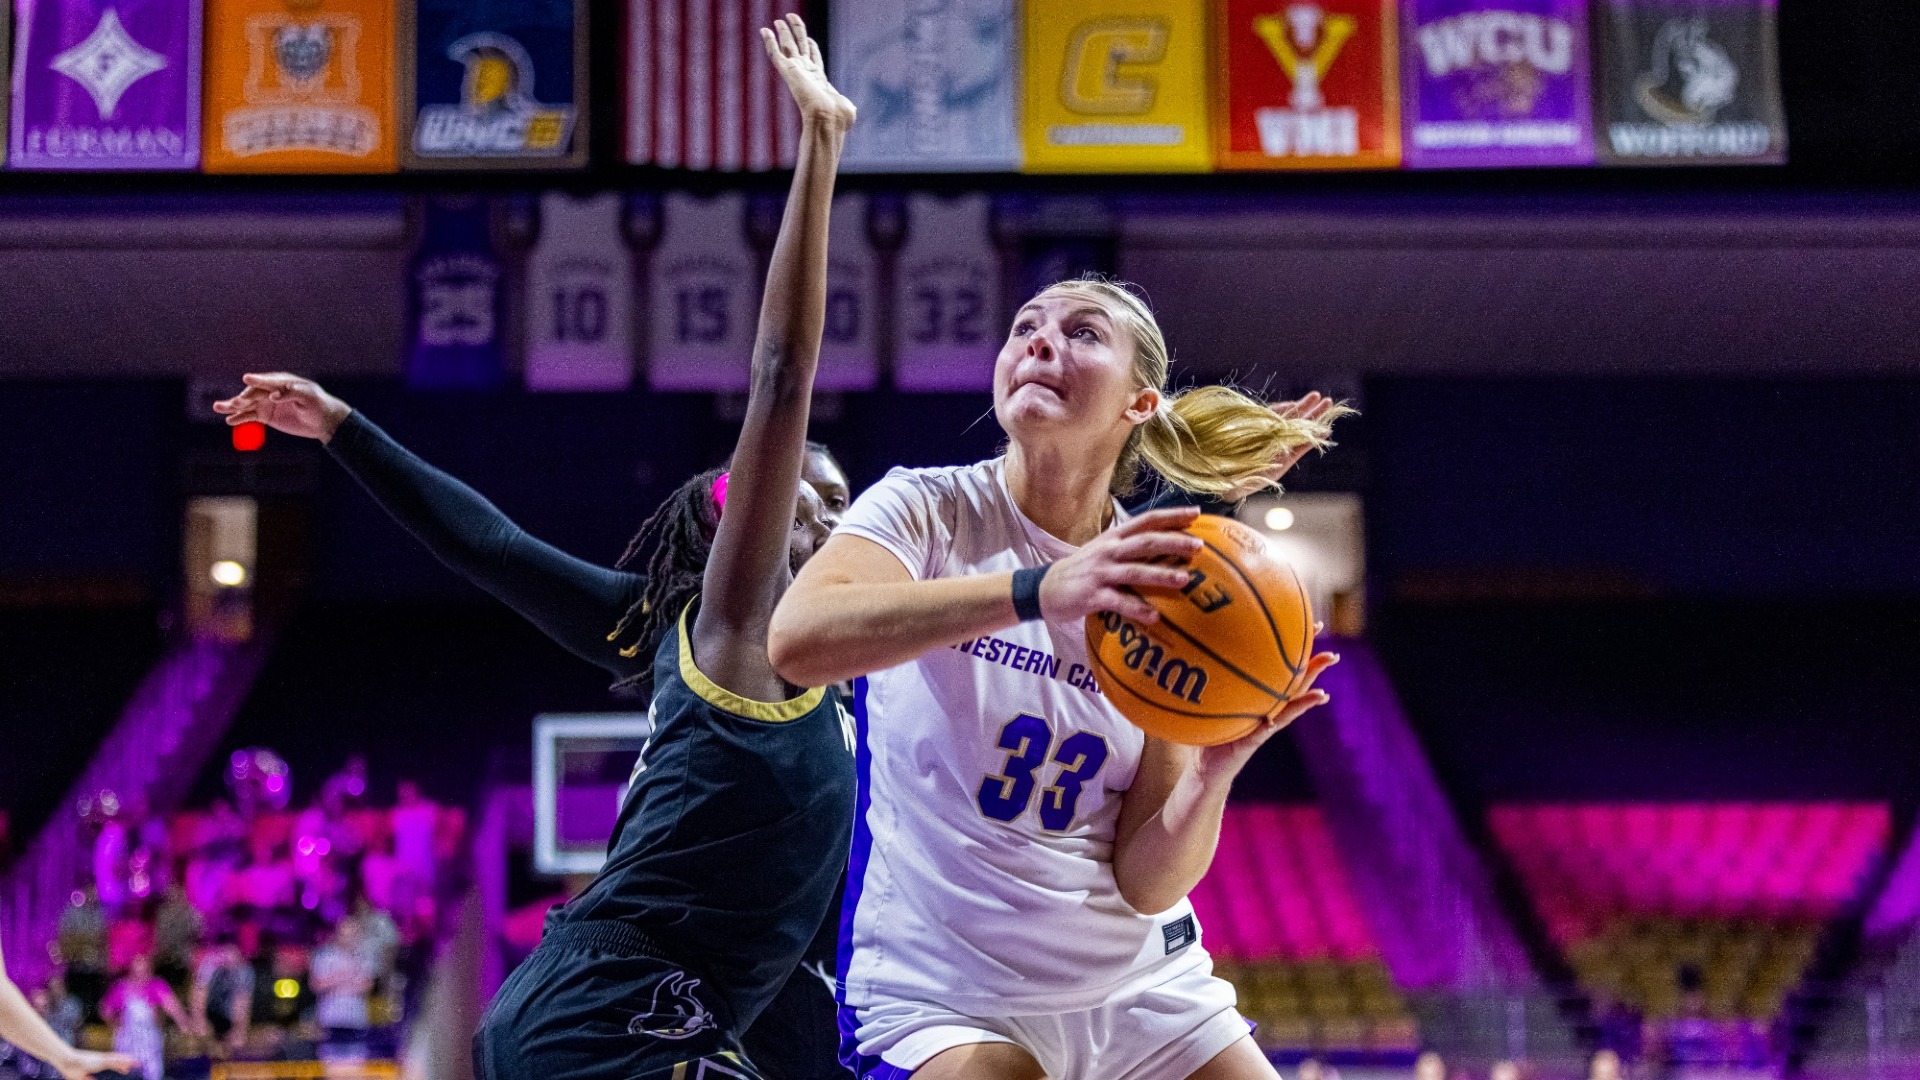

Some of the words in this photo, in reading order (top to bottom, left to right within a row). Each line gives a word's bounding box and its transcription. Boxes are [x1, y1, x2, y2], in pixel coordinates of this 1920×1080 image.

[1419, 10, 1572, 77] WCU
[556, 287, 607, 342] 10
[676, 286, 729, 342] 15
[825, 285, 860, 342] 0
[914, 285, 984, 342] 32
[1066, 663, 1103, 694] CA
[976, 711, 1111, 833] 33
